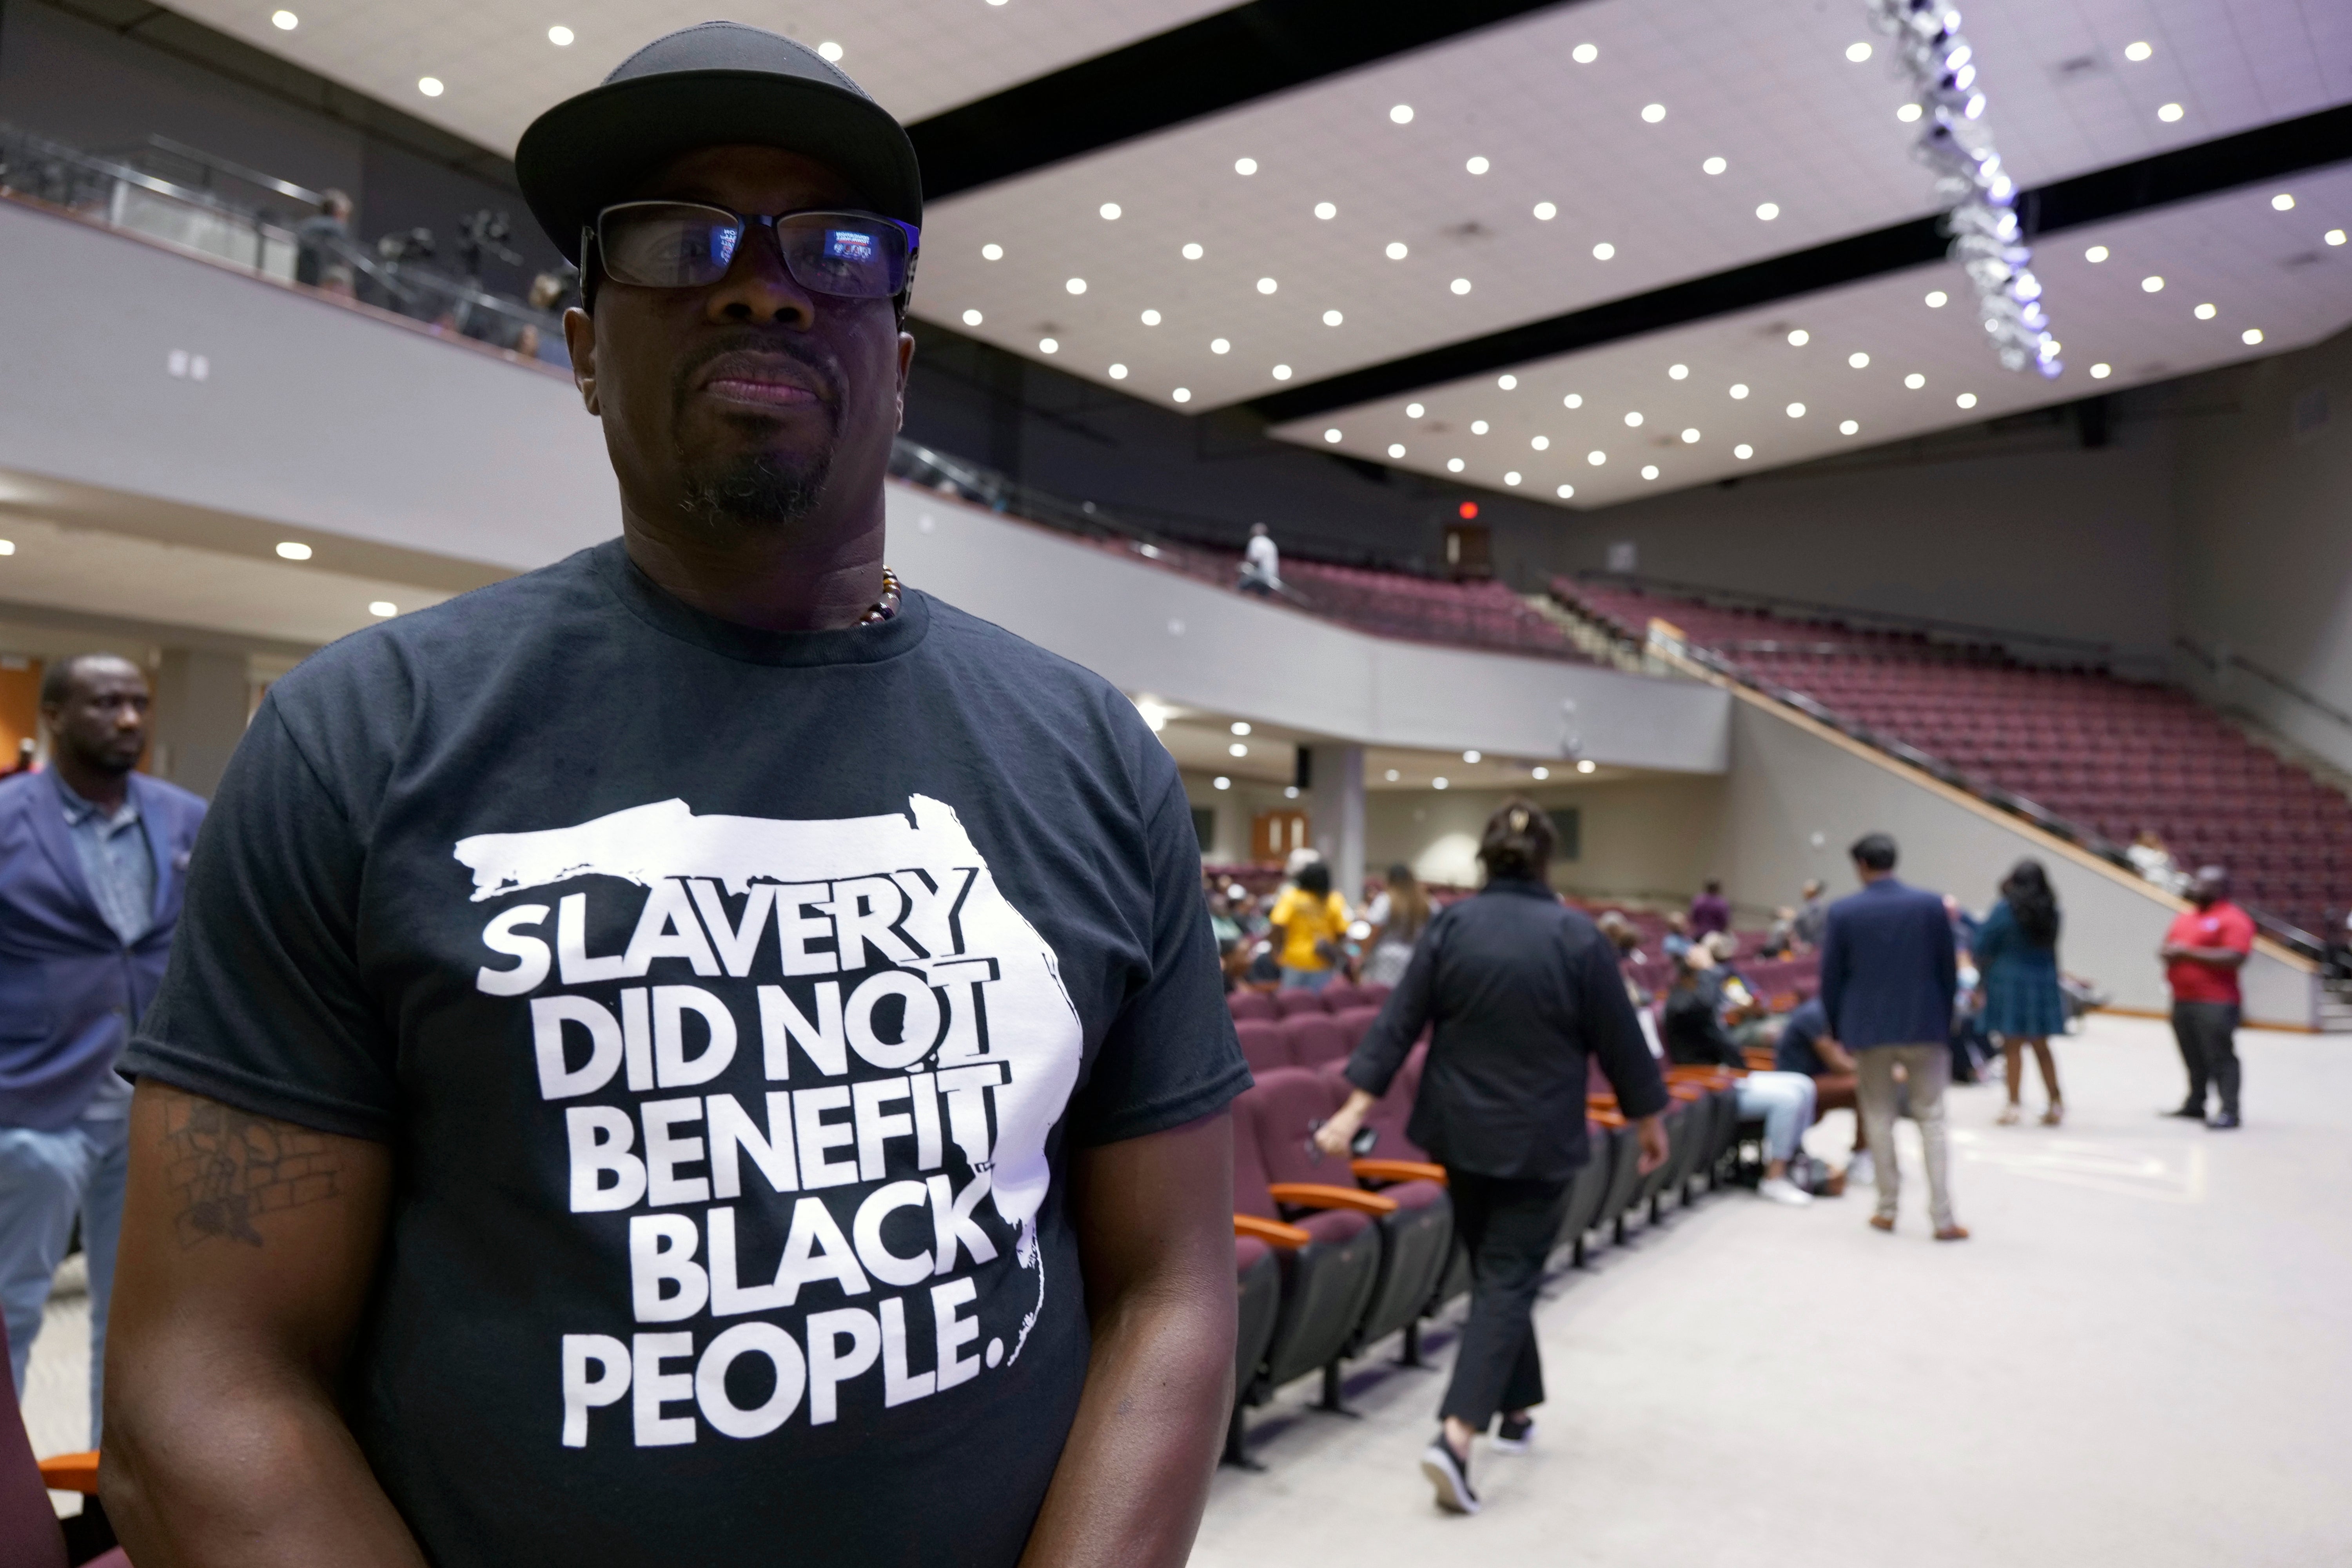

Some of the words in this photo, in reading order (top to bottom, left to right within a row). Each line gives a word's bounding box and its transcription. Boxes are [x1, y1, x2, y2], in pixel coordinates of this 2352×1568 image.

[475, 868, 978, 996] SLAVERY
[530, 984, 738, 1100] DID
[757, 958, 999, 1082] NOT
[566, 1062, 1010, 1212] BENEFIT
[630, 1170, 998, 1322] BLACK
[562, 1277, 1004, 1447] PEOPLE.
